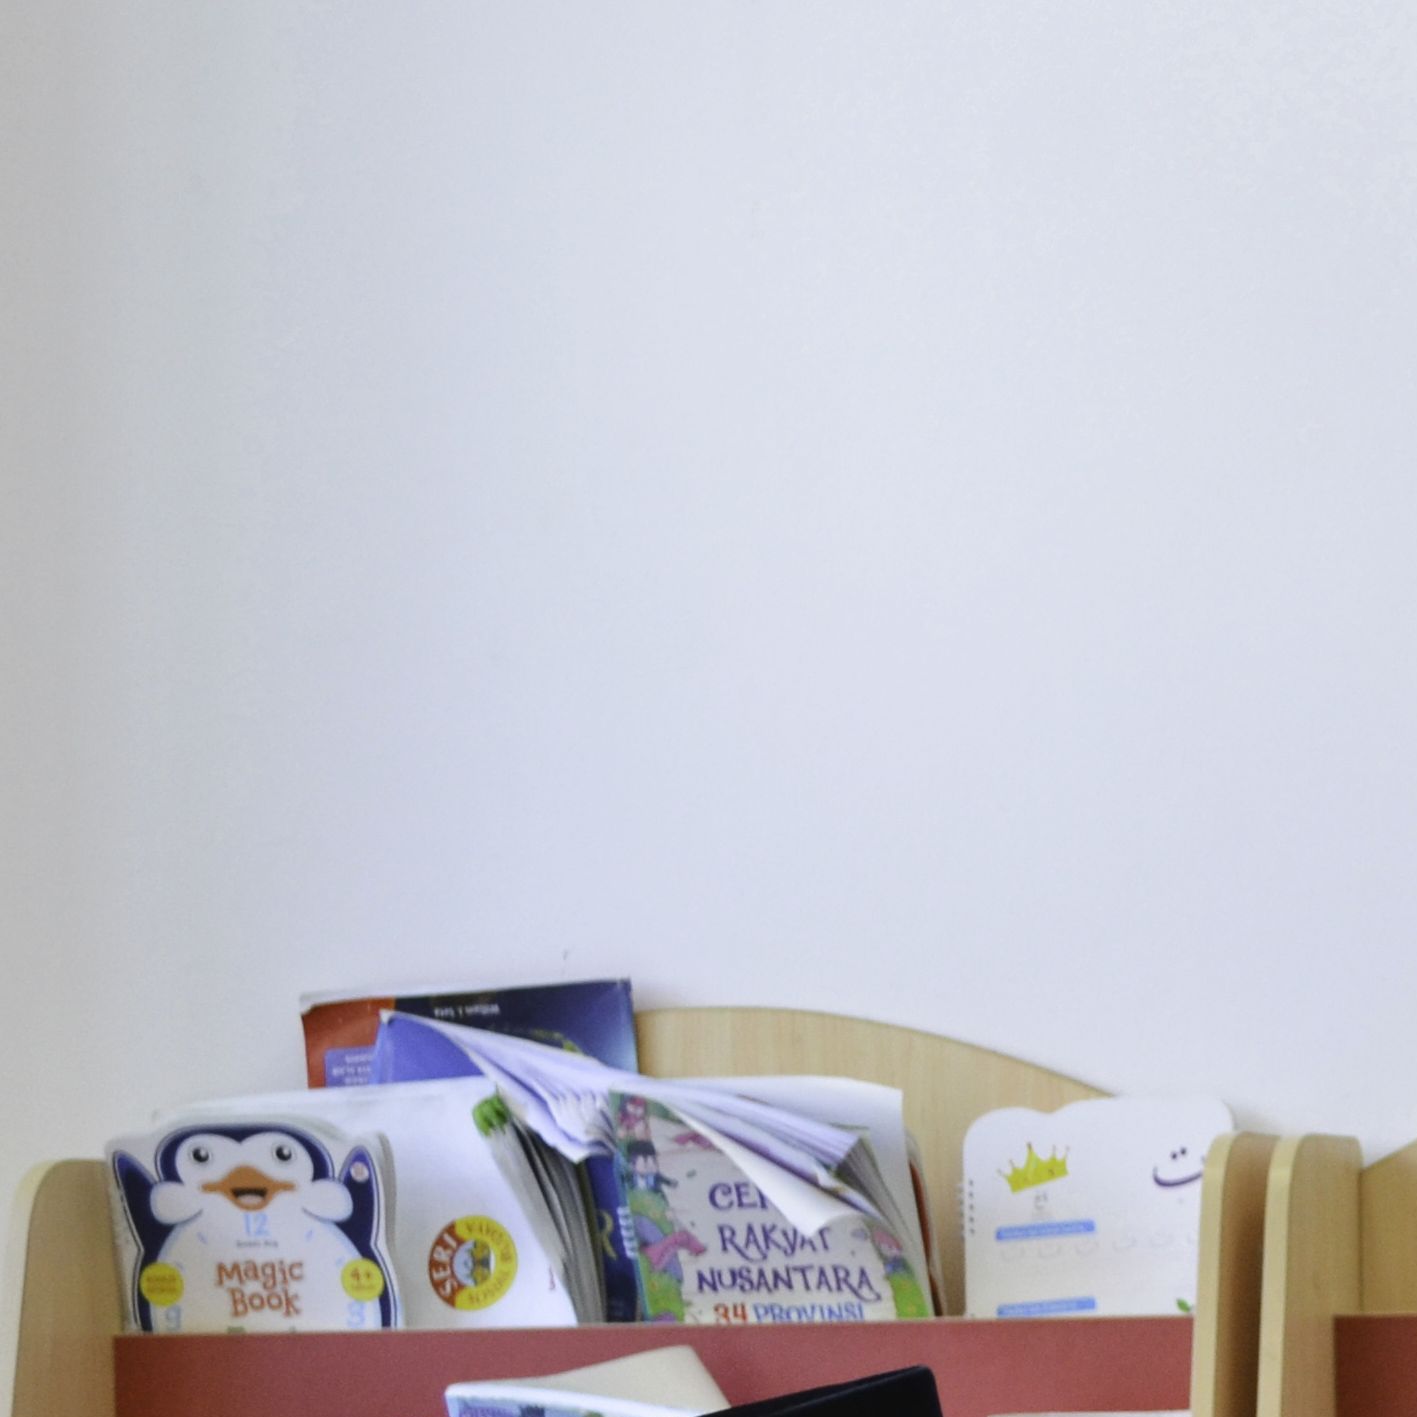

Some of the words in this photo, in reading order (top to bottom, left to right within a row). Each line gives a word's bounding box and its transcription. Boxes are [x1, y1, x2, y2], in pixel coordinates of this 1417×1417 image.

[216, 1259, 303, 1289] Magic
[697, 1264, 882, 1301] NUSANTARA
[228, 1287, 300, 1318] Book
[714, 1302, 748, 1323] 34
